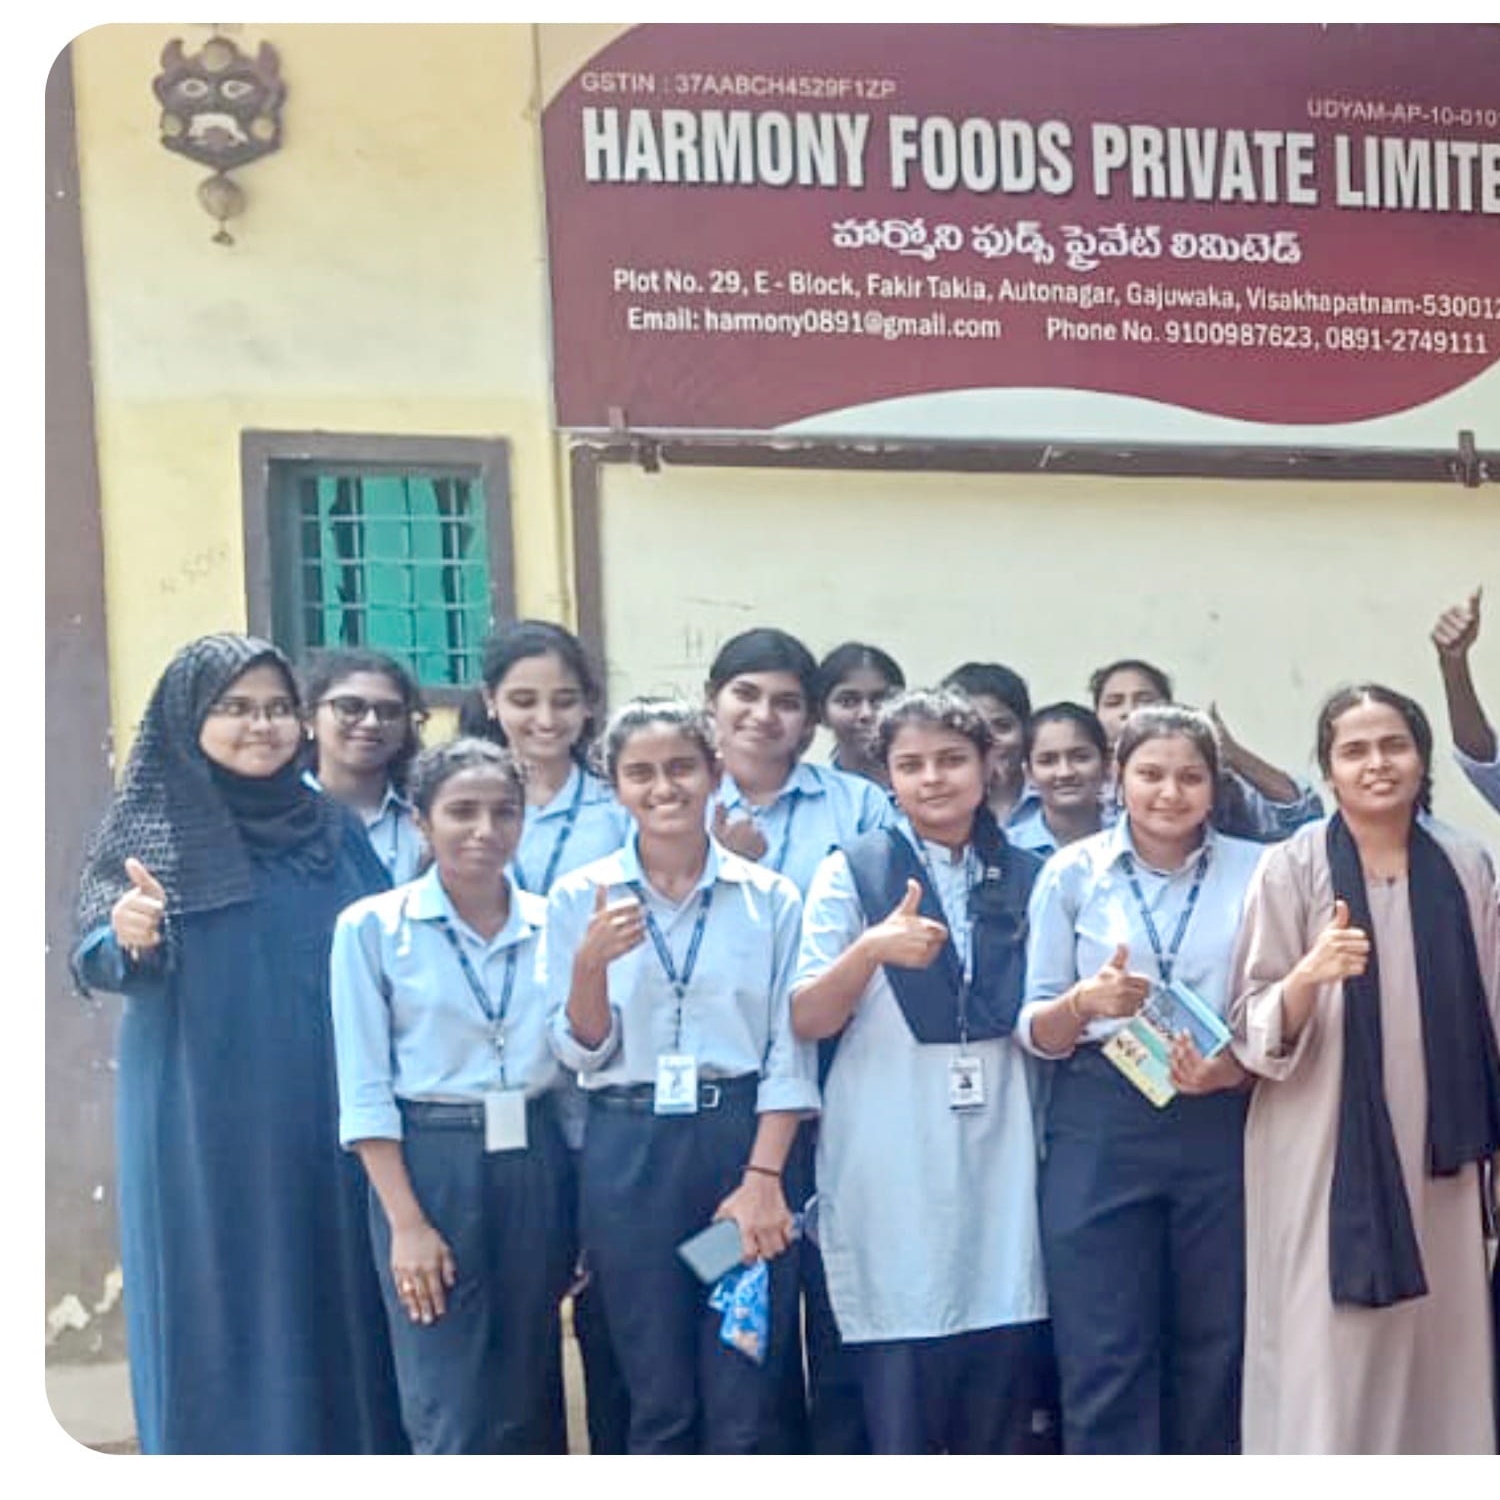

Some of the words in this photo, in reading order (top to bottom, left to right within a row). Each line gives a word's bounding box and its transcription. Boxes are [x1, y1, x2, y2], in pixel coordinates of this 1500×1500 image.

[581, 71, 655, 92] GSTIN
[581, 105, 870, 189] HARMONY
[889, 115, 1074, 195] FOODS
[1091, 122, 1319, 205] PRIVATE
[613, 268, 660, 293] Plot
[664, 269, 704, 293] No.
[709, 270, 749, 297] 29,
[754, 270, 770, 294] E
[789, 271, 862, 299] Block,
[867, 273, 922, 298] Fakir
[926, 275, 994, 302] Takia,
[998, 278, 1121, 309] Autonagar,
[1127, 282, 1243, 312] Gajuwaka,
[628, 306, 699, 331] Email:
[704, 307, 1002, 340] harmony0891@gmail.com
[1047, 317, 1117, 341] Phone
[1122, 319, 1161, 342] No.
[1164, 320, 1320, 350] 9100987623,
[1325, 325, 1489, 355] 0891-2749111
